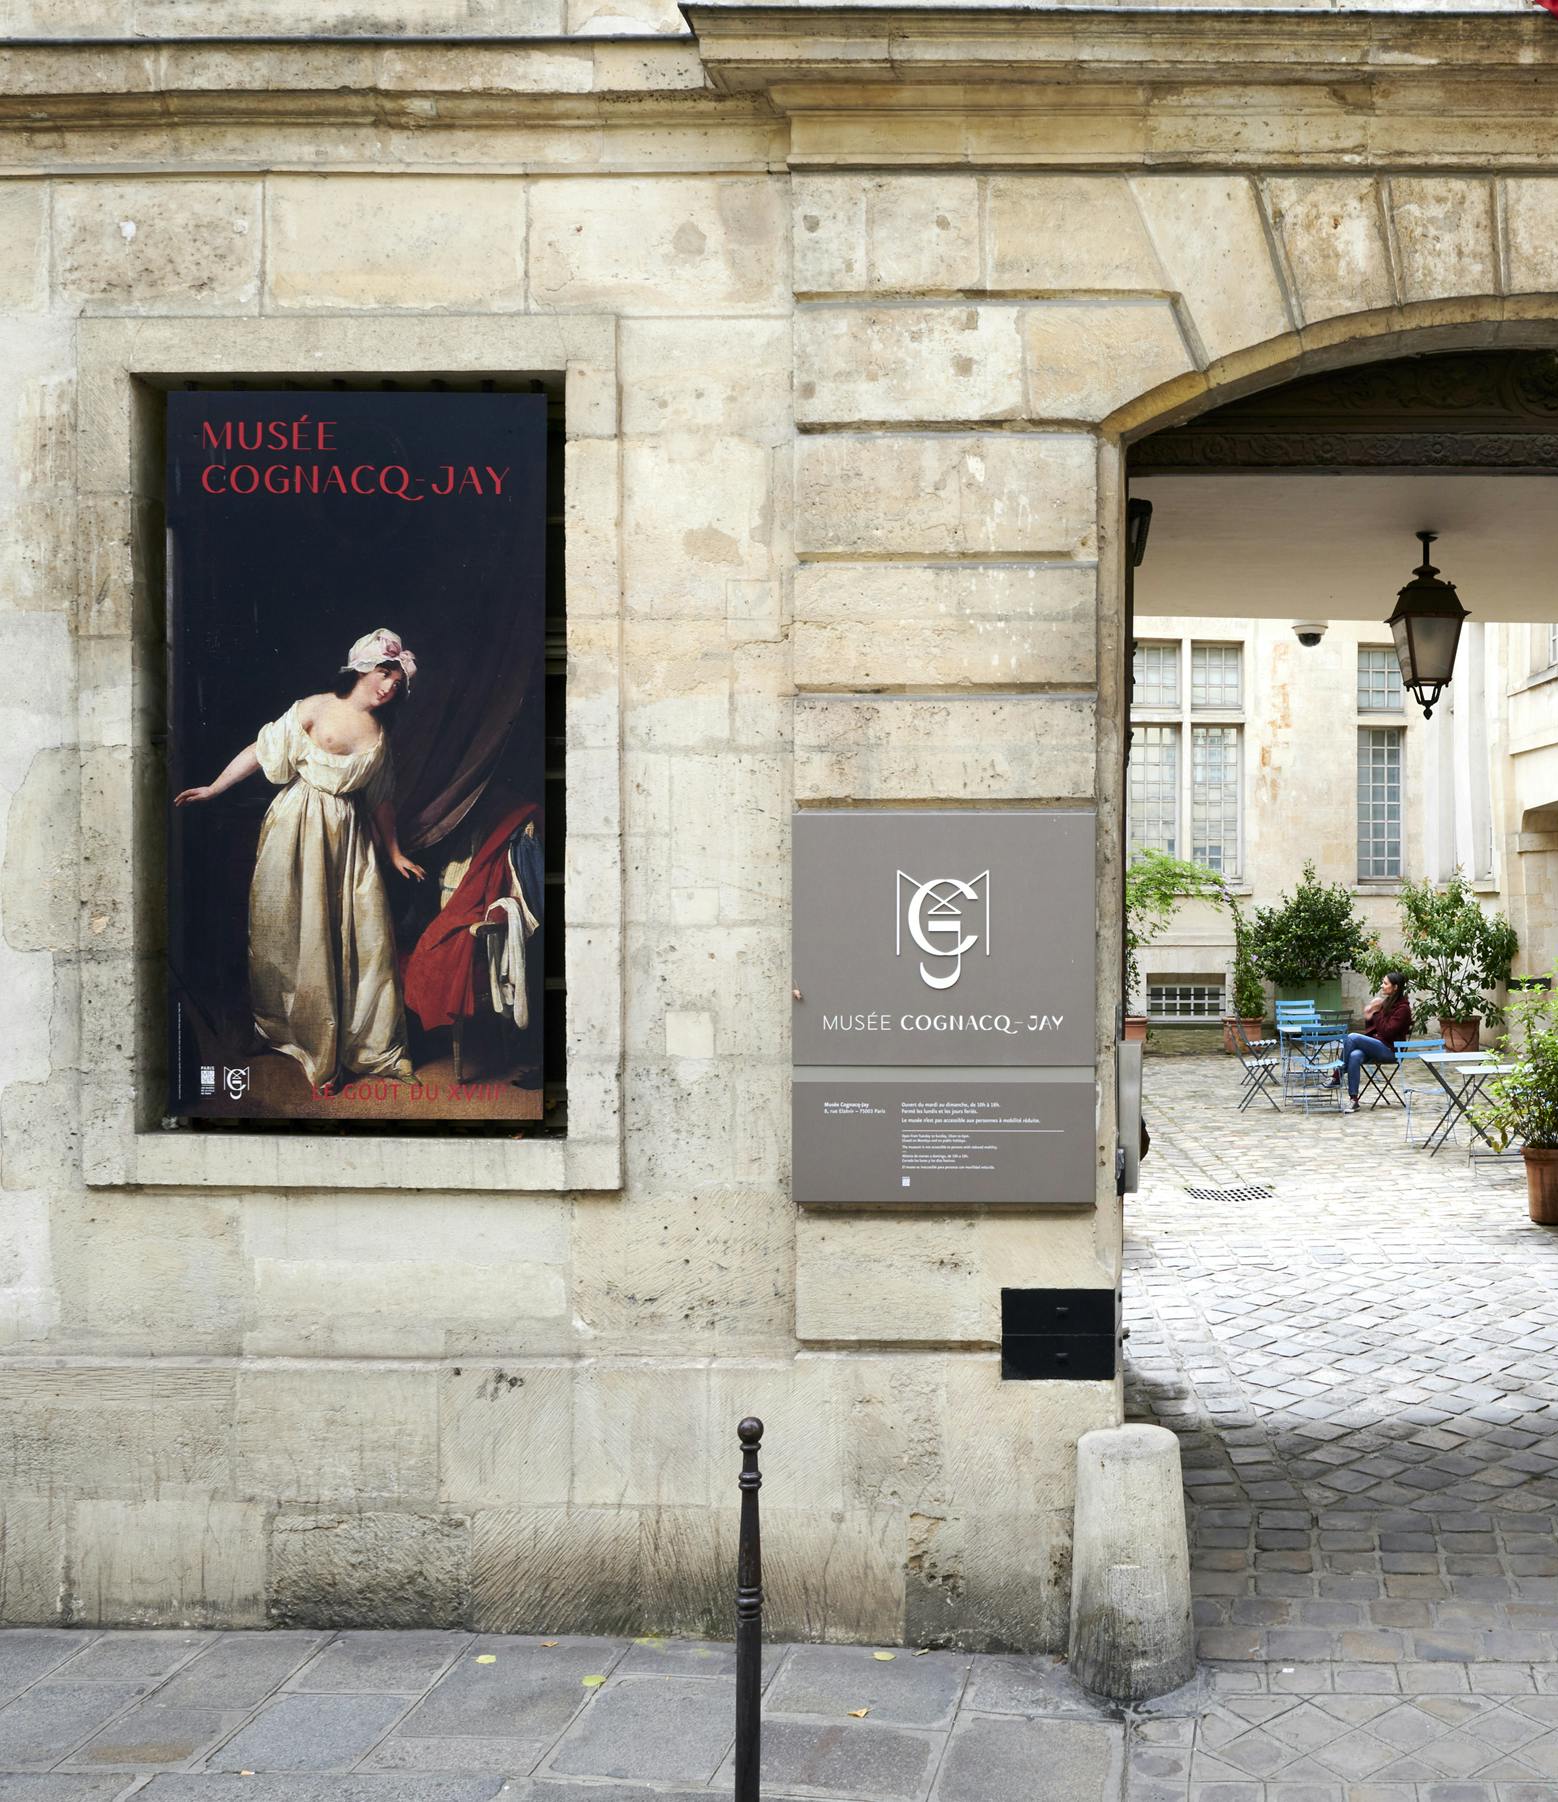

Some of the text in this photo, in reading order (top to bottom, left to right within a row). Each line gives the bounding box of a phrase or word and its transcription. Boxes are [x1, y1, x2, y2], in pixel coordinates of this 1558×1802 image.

[202, 414, 338, 450] MUSÉE
[201, 464, 512, 501] COGNACQ-JAY
[822, 1012, 1064, 1034] MUSÉE COGNACQ-JAY
[313, 1084, 335, 1101] LE
[344, 1080, 401, 1102] GOÛT
[410, 1085, 439, 1101] DU
